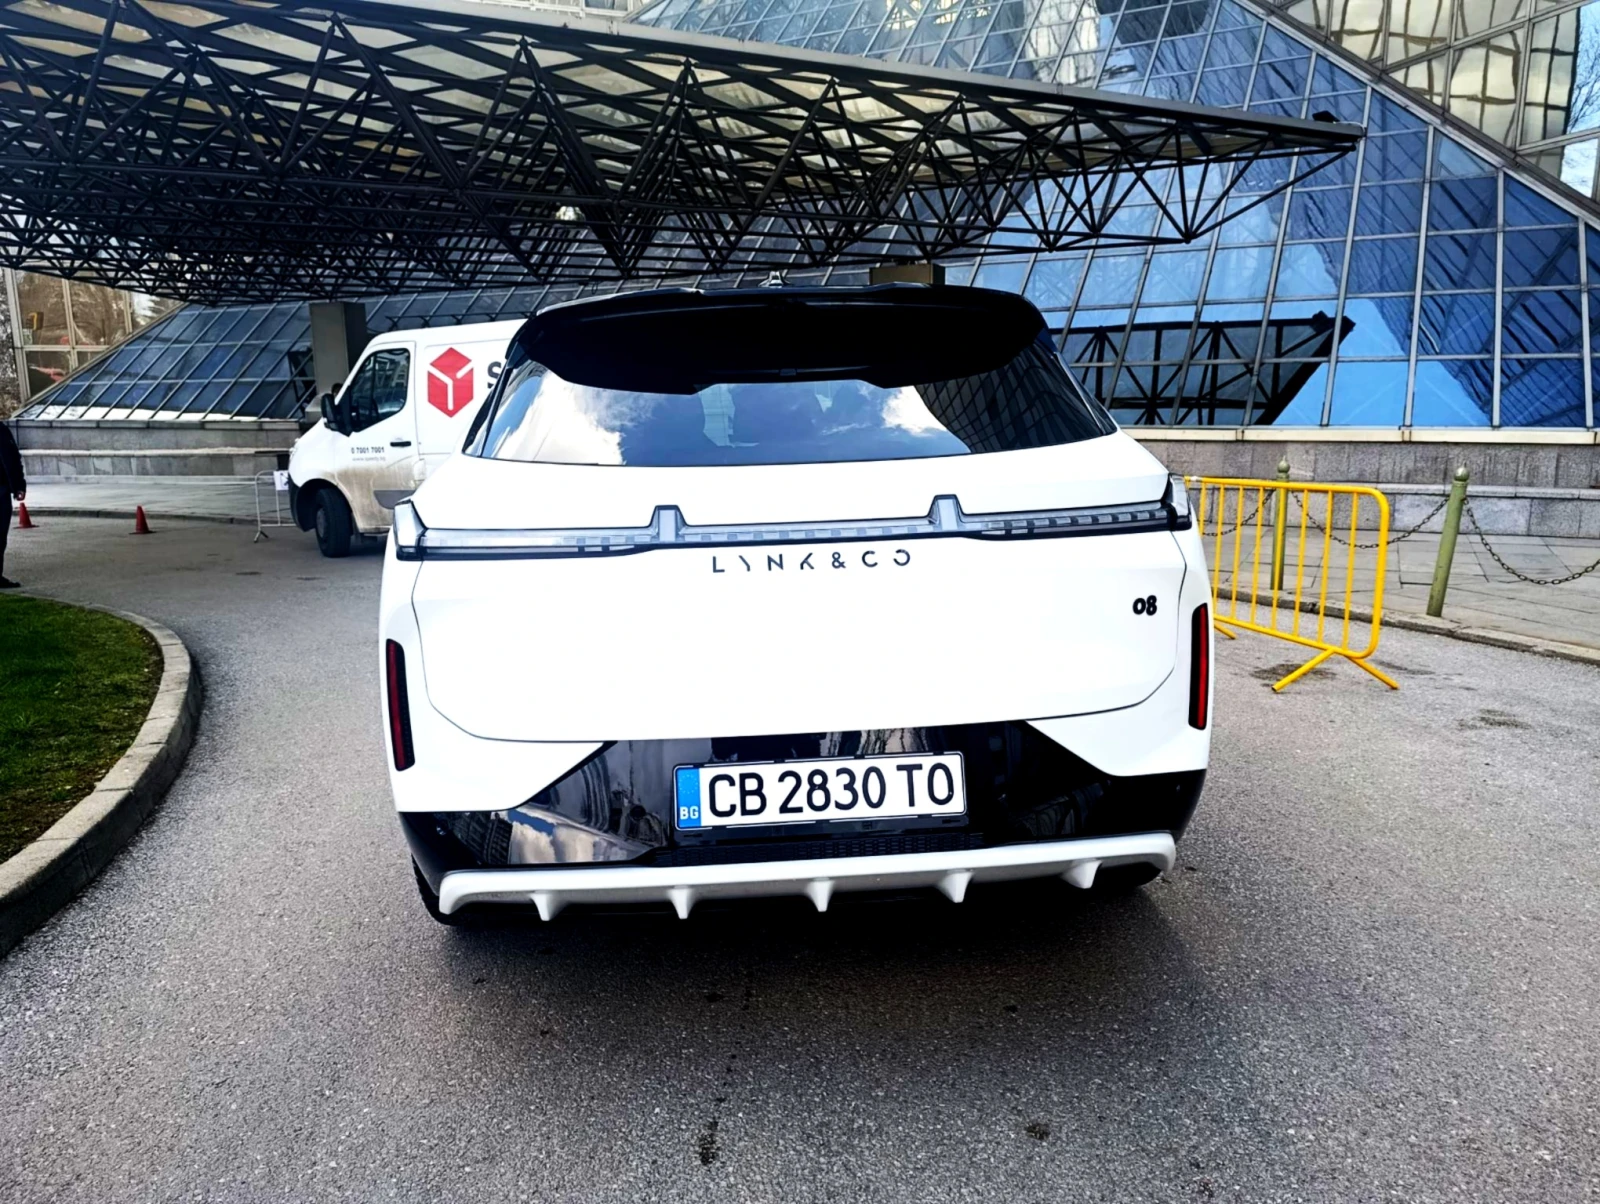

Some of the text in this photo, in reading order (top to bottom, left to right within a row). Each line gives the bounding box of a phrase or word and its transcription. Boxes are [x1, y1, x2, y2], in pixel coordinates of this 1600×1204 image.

[1132, 594, 1158, 616] 08
[708, 762, 954, 817] CB 2830 TO
[679, 806, 699, 820] BG
